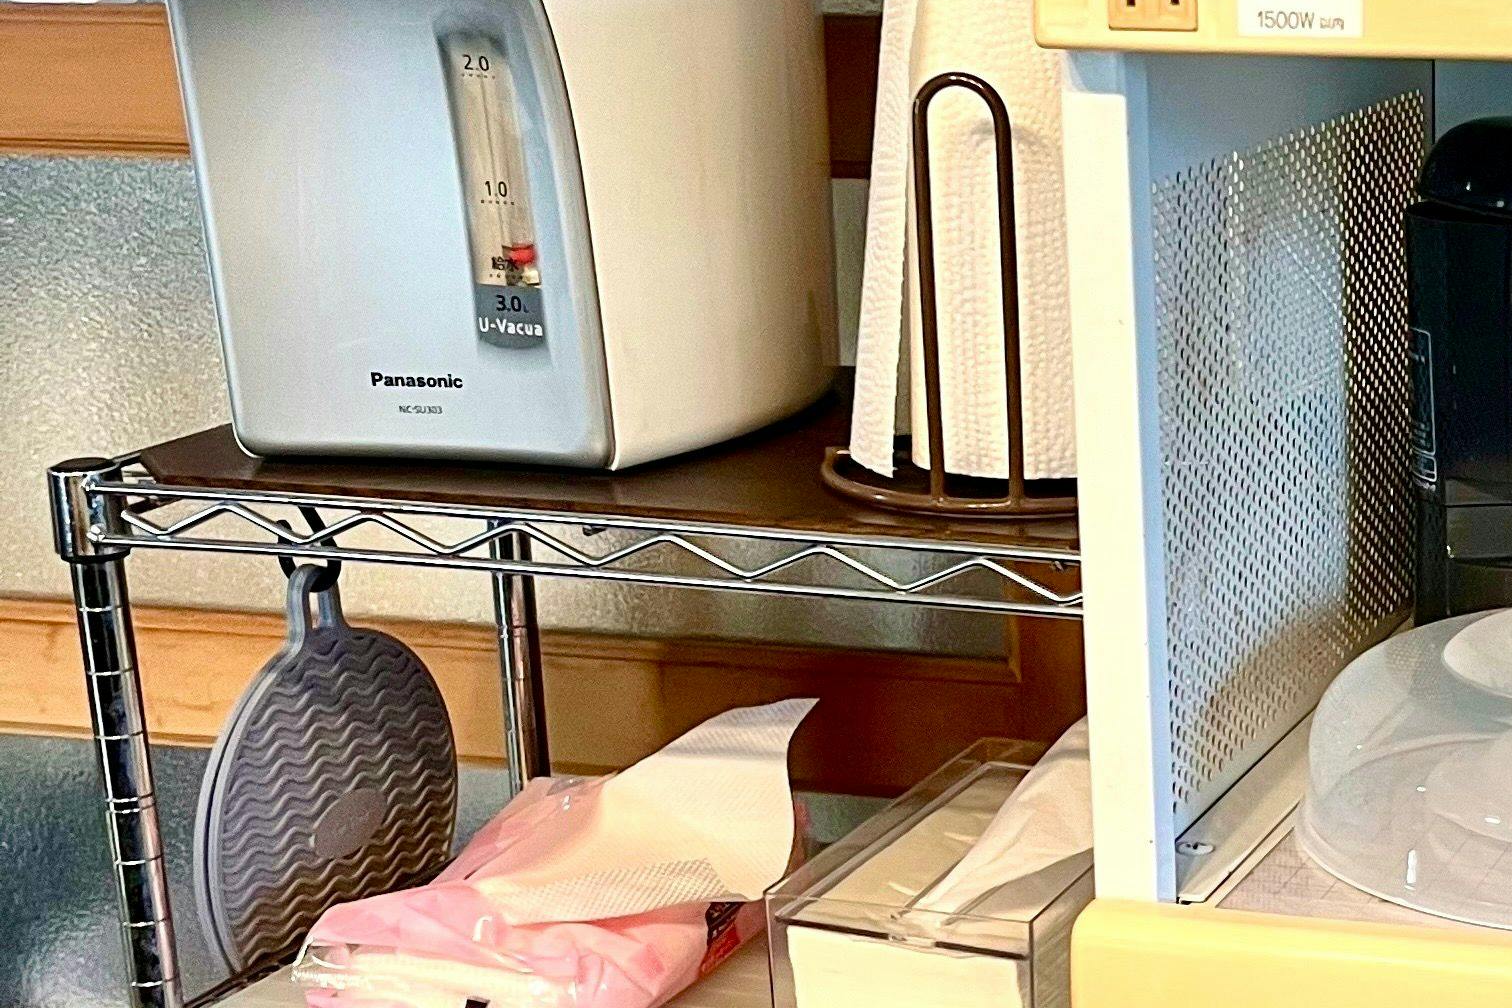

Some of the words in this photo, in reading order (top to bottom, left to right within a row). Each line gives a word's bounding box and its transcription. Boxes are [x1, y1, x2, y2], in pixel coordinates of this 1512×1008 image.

[1257, 10, 1315, 30] 1500W
[463, 54, 490, 73] 2.0
[485, 180, 508, 198] 1.0
[478, 316, 543, 337] U-Vacua
[370, 371, 464, 390] Panasonic
